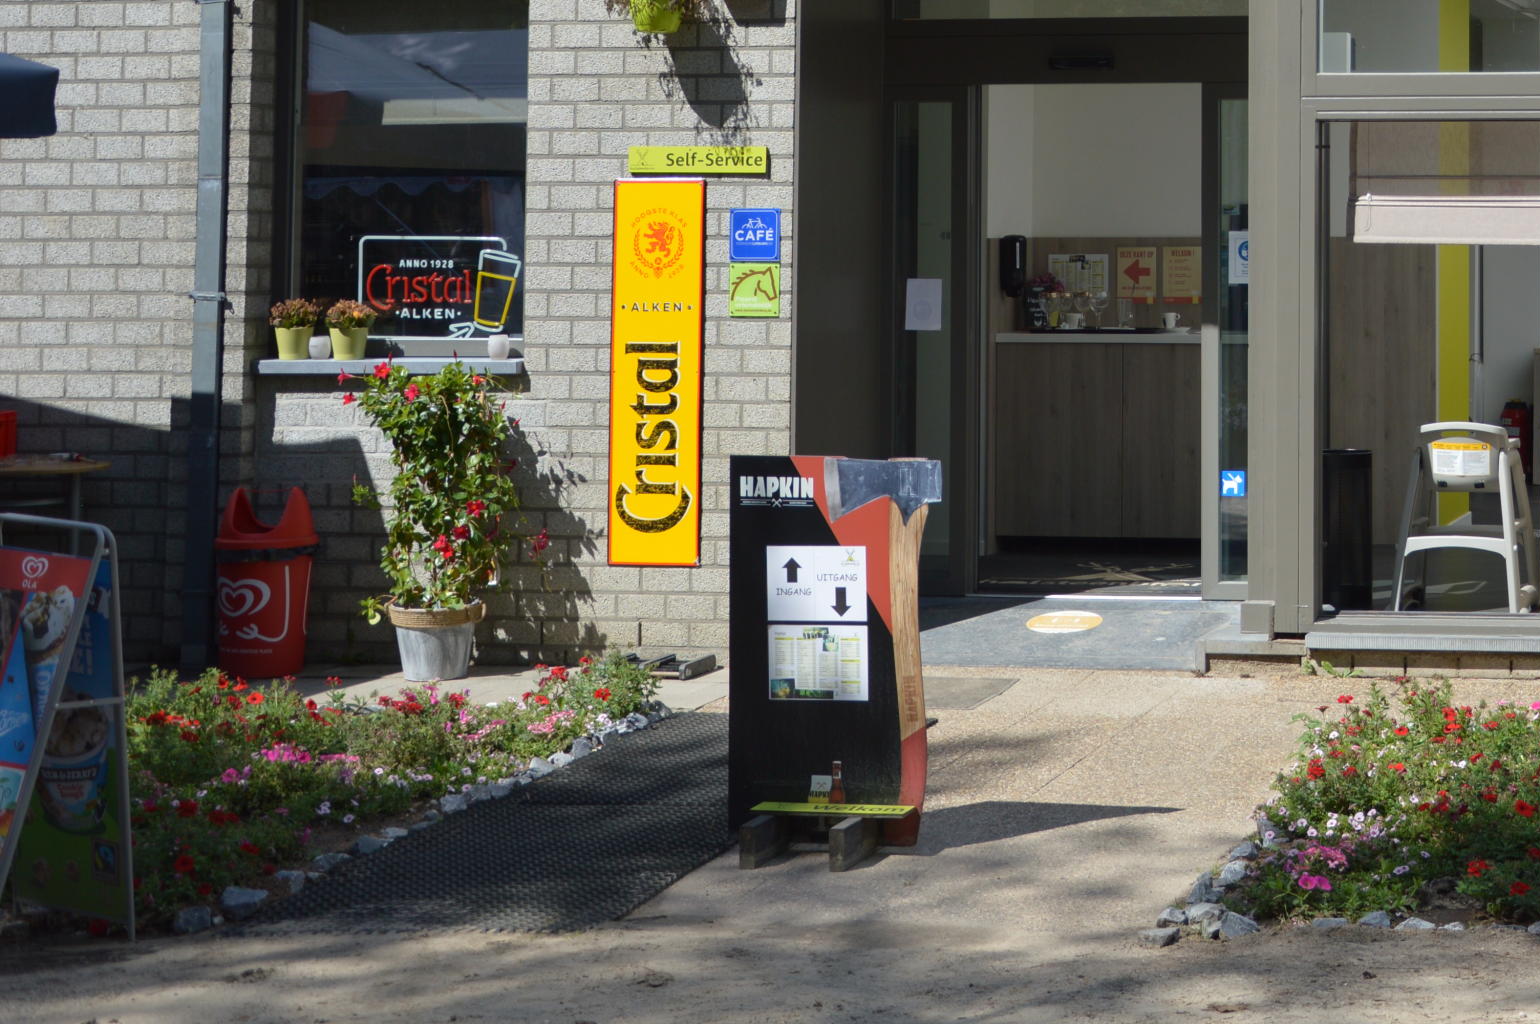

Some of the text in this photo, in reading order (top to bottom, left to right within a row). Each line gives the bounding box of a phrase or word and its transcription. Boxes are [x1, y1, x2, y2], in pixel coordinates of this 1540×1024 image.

[665, 151, 763, 167] Self-Service
[734, 227, 774, 241] CAFÉ
[399, 259, 454, 269] ANNO 1928
[366, 264, 472, 311] Cristal
[631, 302, 683, 313] ALKEN
[400, 308, 455, 319] ALKEN
[615, 340, 693, 534] Cristal
[740, 475, 814, 498] HAPKIN
[816, 573, 858, 582] UITGANG
[775, 587, 812, 596] INGANG
[813, 803, 905, 813] Welkom
